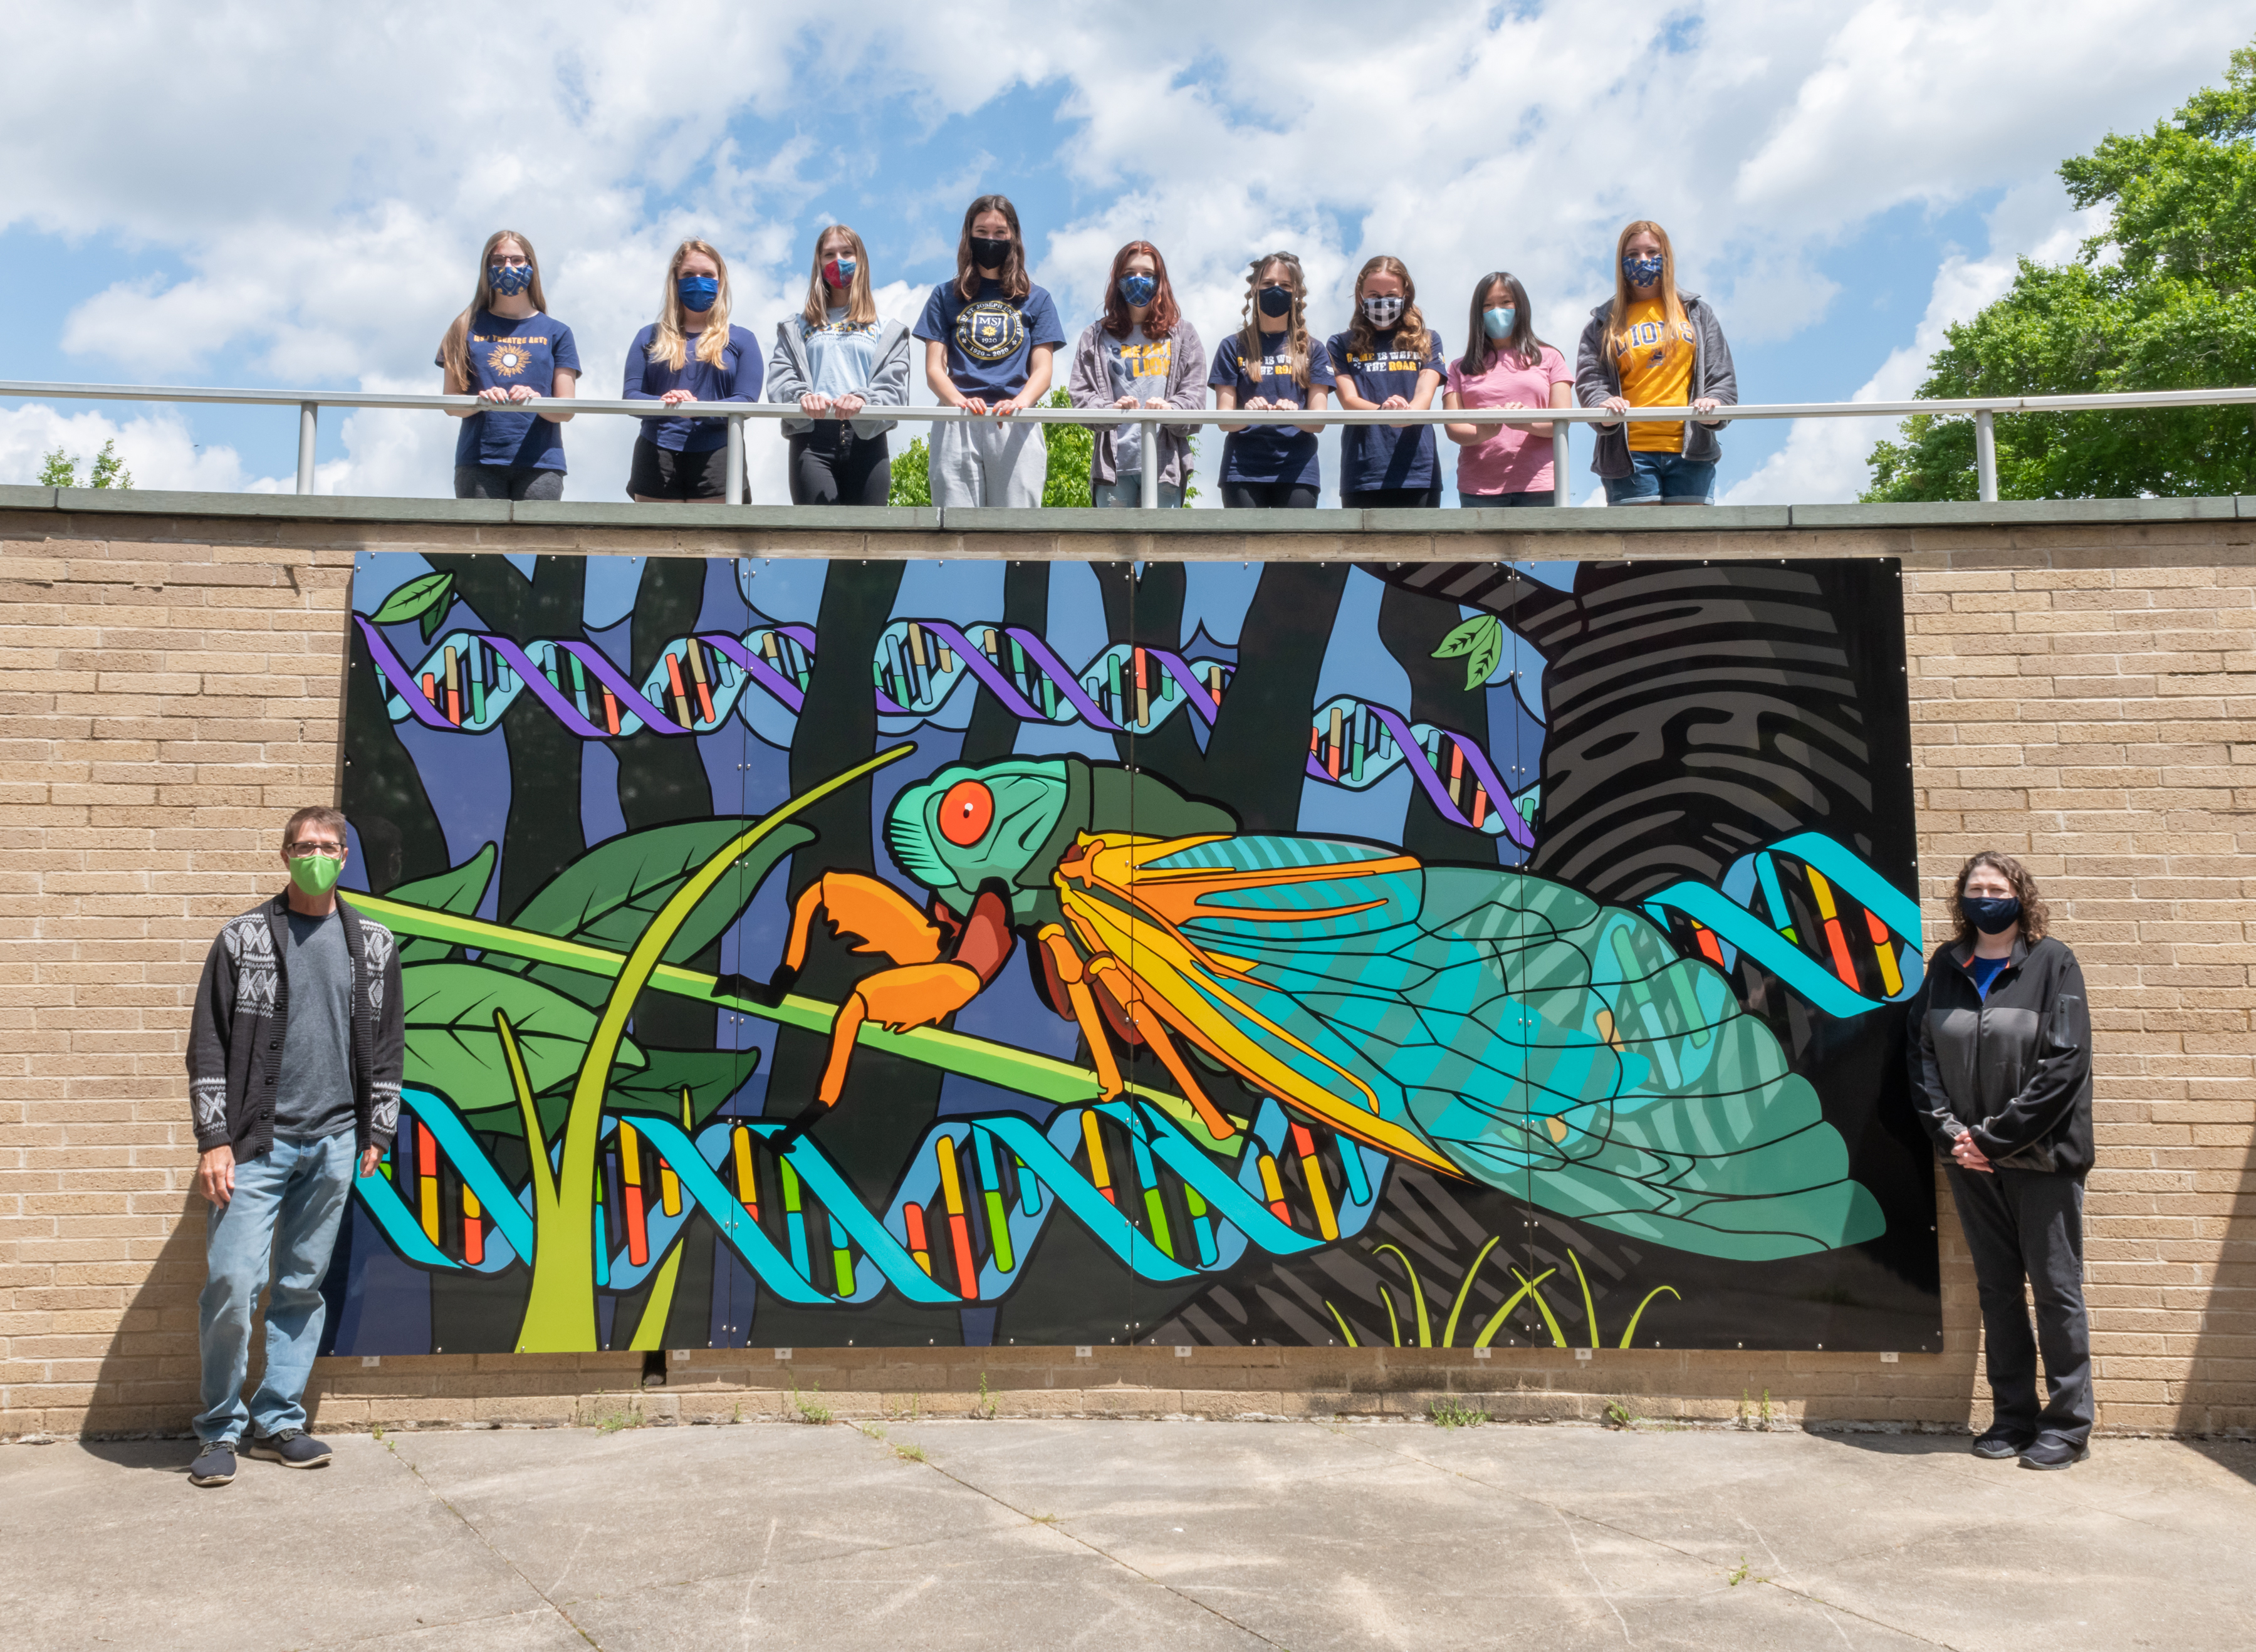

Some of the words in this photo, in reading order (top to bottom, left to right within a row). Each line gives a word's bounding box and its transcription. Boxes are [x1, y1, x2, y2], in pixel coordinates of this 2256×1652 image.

[966, 307, 976, 315] ST.
[979, 317, 1001, 327] MSJ
[493, 334, 527, 345] THEATRE
[528, 337, 548, 345] ARTS
[969, 346, 985, 356] 1920
[992, 347, 1009, 357] 2020
[1377, 352, 1387, 360] IS
[1389, 351, 1421, 360] WHER
[1265, 356, 1275, 365] IS
[1260, 366, 1273, 375] HE
[1364, 362, 1387, 372] THE
[1388, 361, 1416, 371] ROAR
